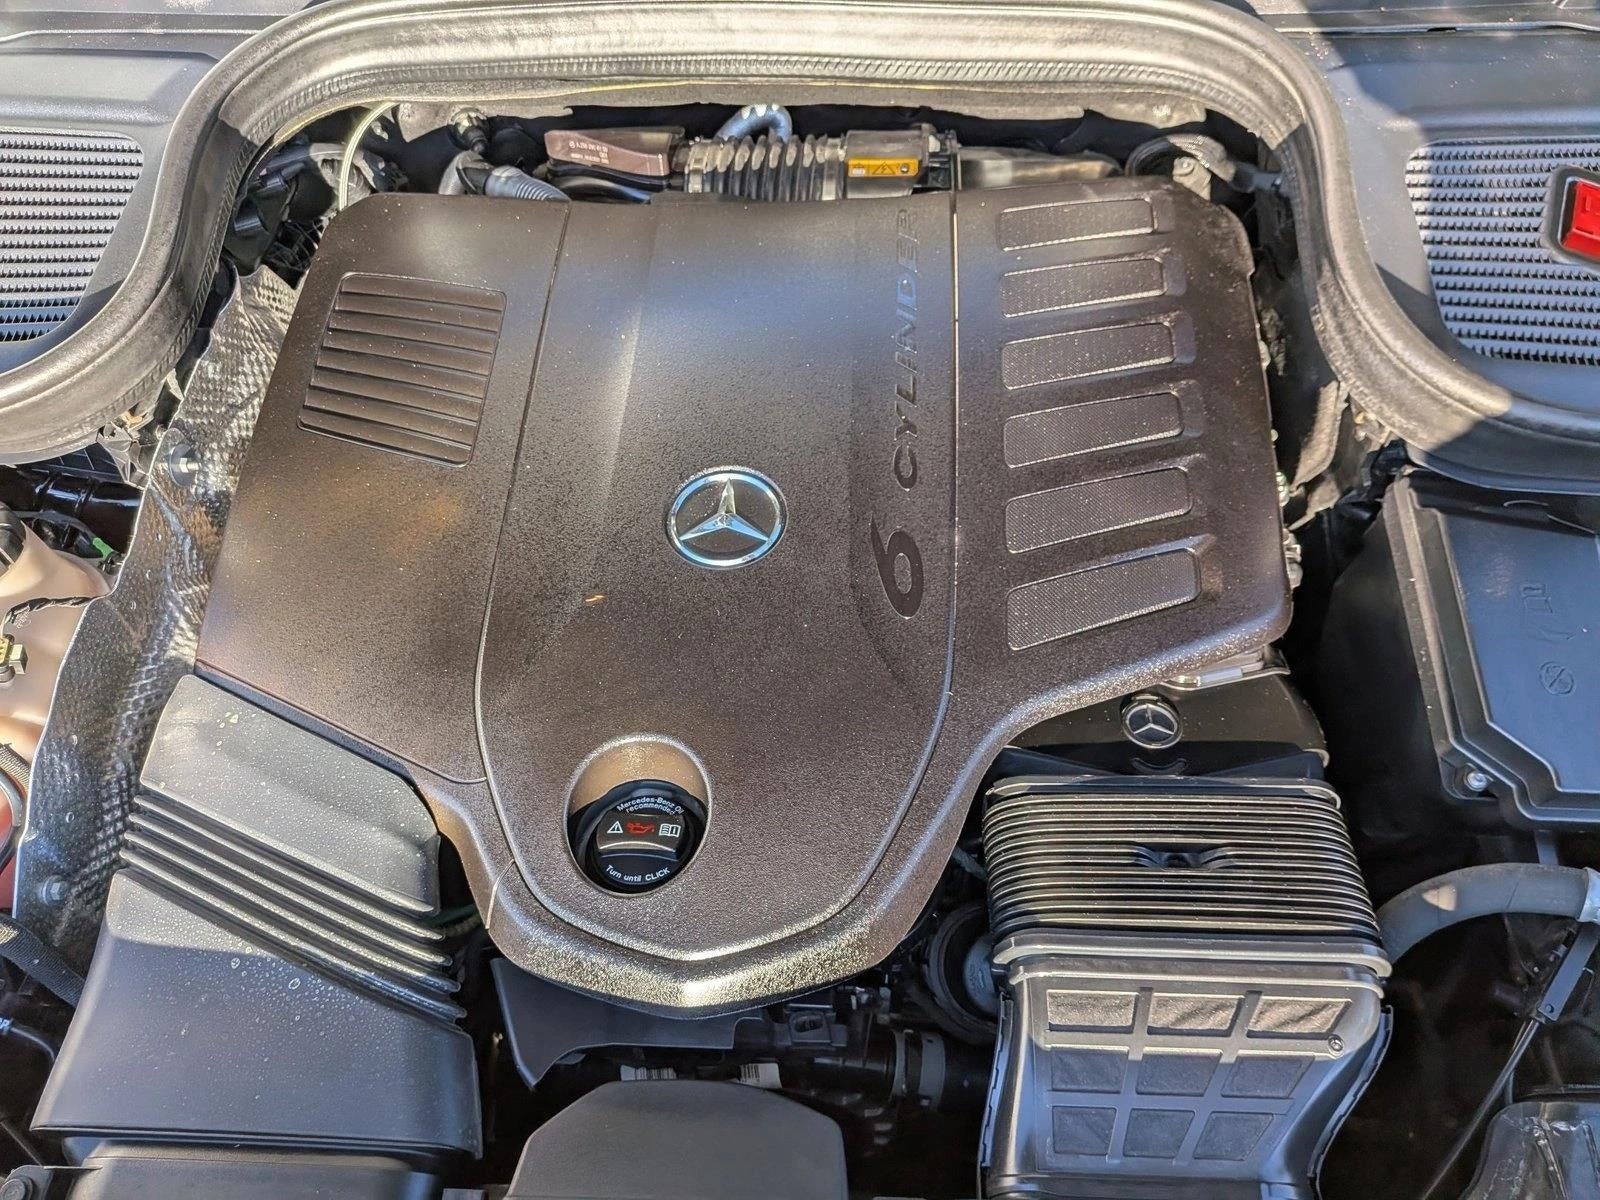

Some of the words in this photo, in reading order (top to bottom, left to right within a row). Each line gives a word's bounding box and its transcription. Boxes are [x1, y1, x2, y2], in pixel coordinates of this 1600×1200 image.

[894, 208, 918, 491] CYLINDER
[870, 514, 924, 619] 6
[616, 797, 675, 811] Mercedes-Benz
[626, 803, 676, 815] recommended
[606, 864, 622, 879] Turn
[624, 874, 642, 882] until
[645, 867, 671, 881] CLICK
